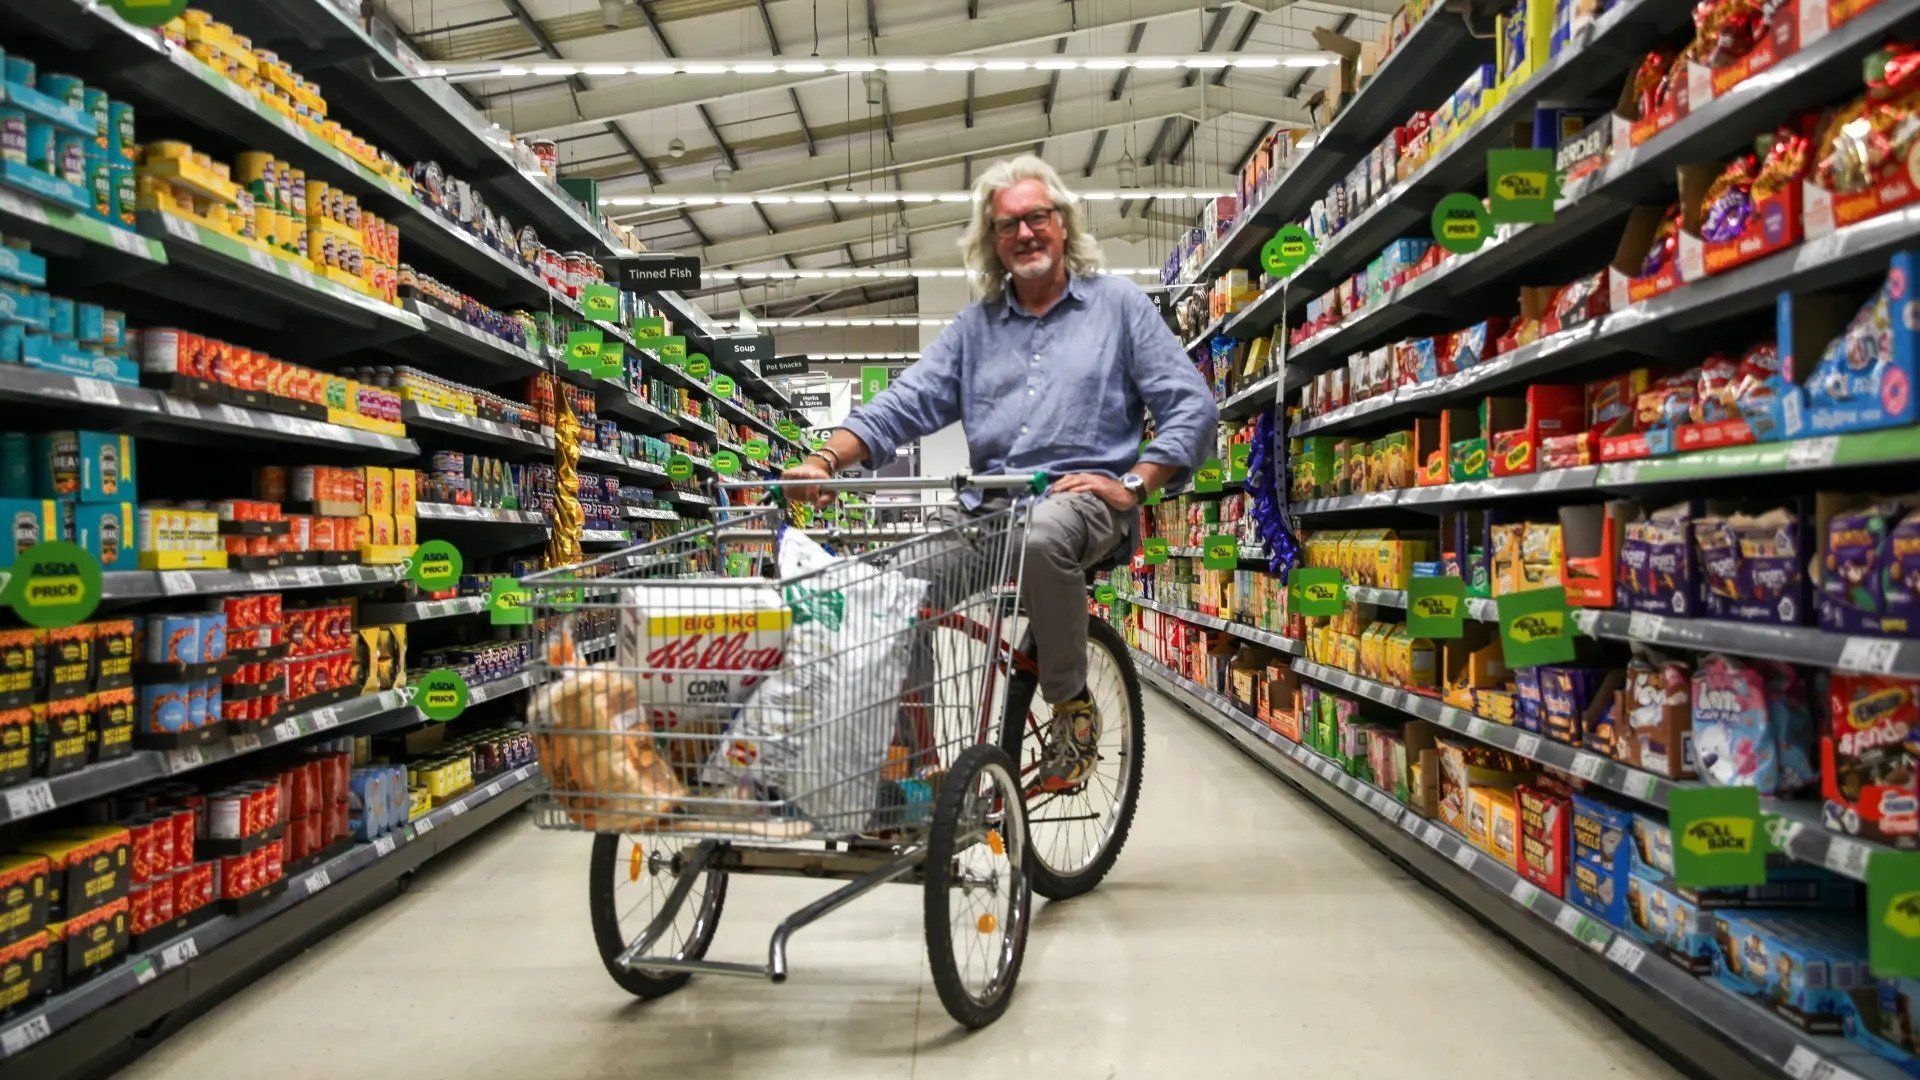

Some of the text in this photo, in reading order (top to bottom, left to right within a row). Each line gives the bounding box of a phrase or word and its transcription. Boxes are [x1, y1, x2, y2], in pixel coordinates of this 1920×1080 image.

[1446, 209, 1476, 218] ASDA
[629, 267, 692, 280] Tinned Fish
[734, 344, 756, 353] Soup
[766, 361, 802, 371] Pot Snacks
[869, 379, 880, 394] 8
[423, 552, 449, 561] ASDA
[31, 562, 79, 576] ASDA
[1428, 607, 1451, 616] BACK
[1529, 626, 1558, 639] BACK
[429, 681, 455, 690] ASDA
[687, 679, 728, 695] CORN
[1708, 838, 1745, 850] BACK
